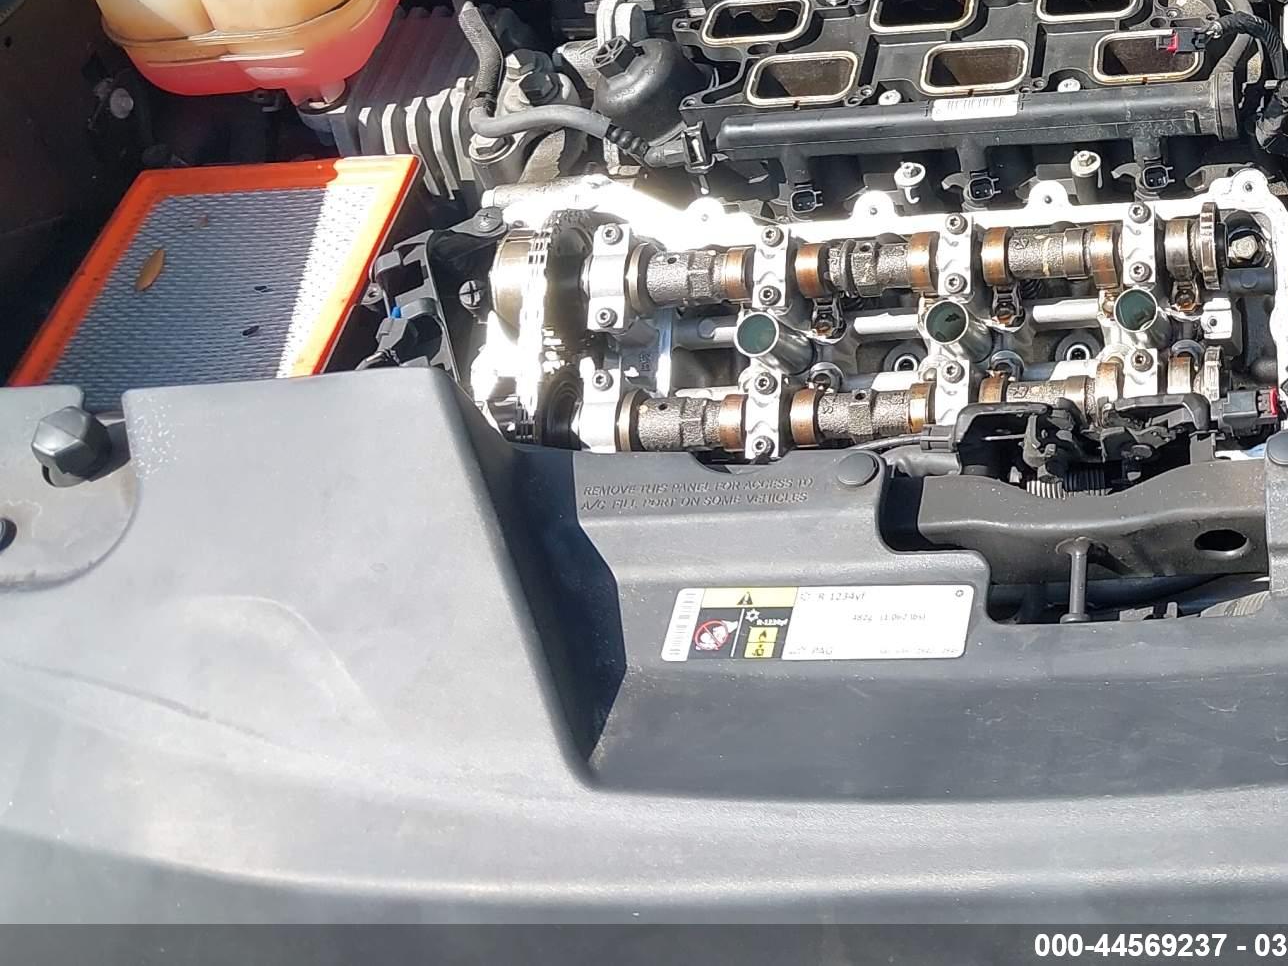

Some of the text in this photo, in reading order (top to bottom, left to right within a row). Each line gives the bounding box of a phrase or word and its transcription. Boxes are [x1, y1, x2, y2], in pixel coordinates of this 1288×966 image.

[583, 486, 636, 496] REMOVE
[681, 497, 700, 506] ON
[703, 495, 741, 506] SOME
